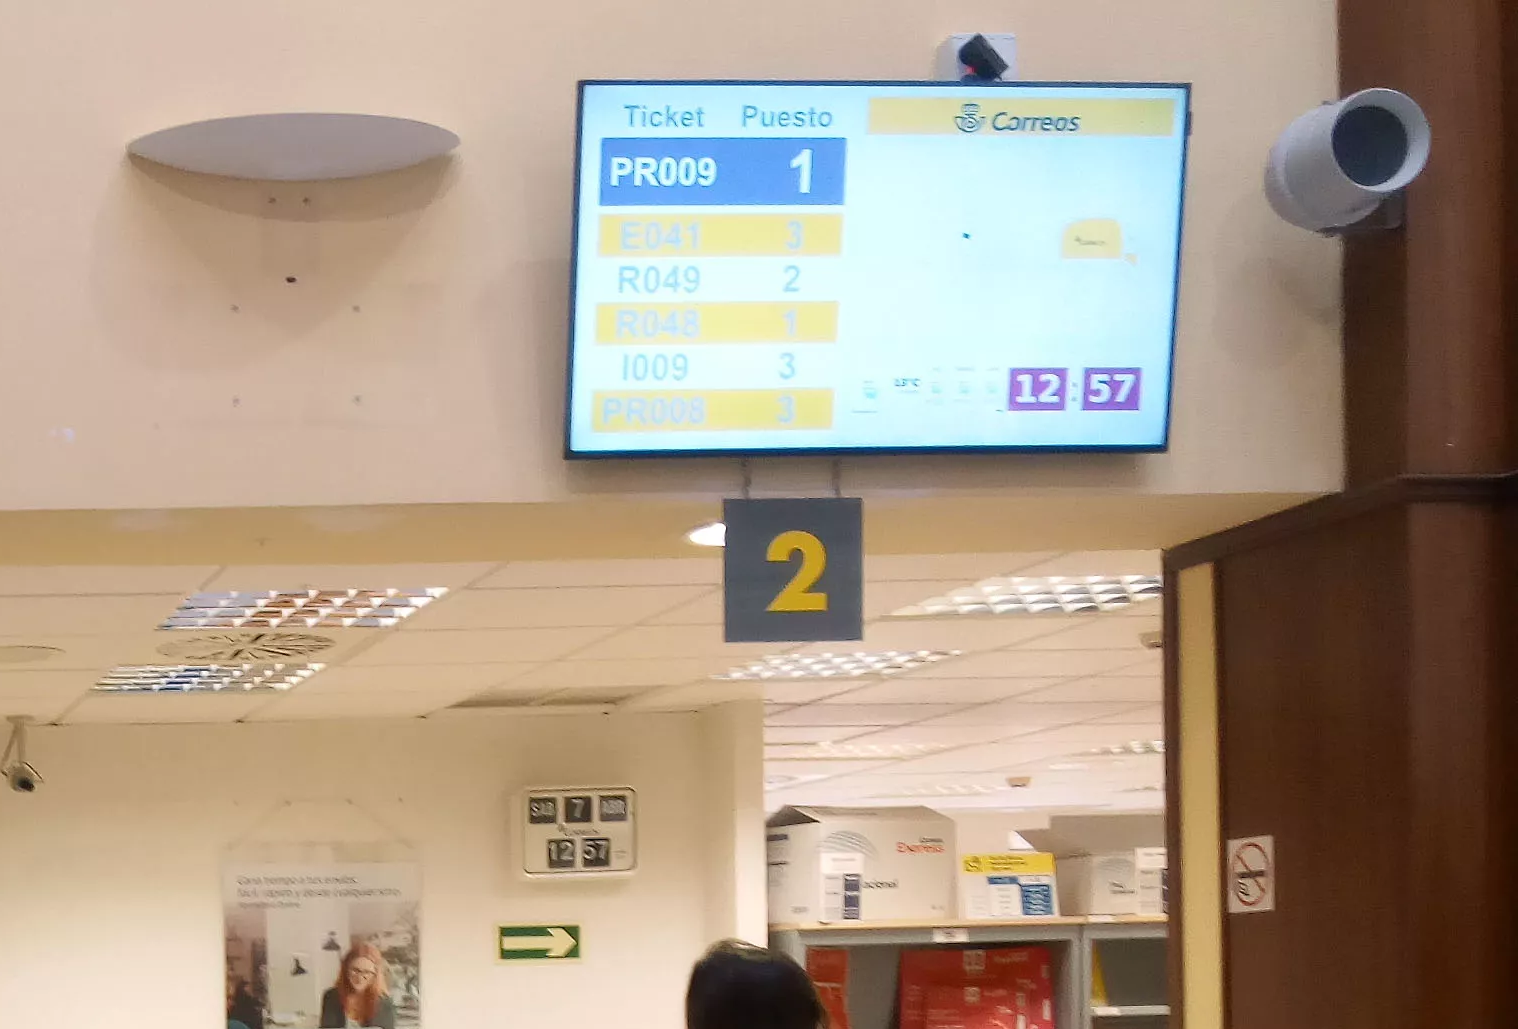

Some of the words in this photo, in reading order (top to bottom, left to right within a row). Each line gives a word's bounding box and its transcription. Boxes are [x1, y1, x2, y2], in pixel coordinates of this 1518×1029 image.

[624, 105, 705, 128] Ticket
[741, 106, 833, 128] Puesto
[991, 112, 1081, 133] Correos
[609, 157, 717, 188] PR009
[789, 148, 813, 194] 1
[620, 221, 702, 251] E041
[785, 220, 804, 250] 3
[618, 265, 701, 294] R049
[783, 265, 800, 293] 2
[615, 309, 701, 339] R048
[783, 310, 797, 337] 1
[778, 353, 796, 380] 3
[1015, 373, 1062, 404] 12
[1088, 373, 1137, 404] 57
[601, 397, 705, 426] PR008
[775, 396, 795, 425] 3
[764, 530, 829, 613] 2
[571, 798, 585, 819] 7
[549, 841, 575, 861] 12
[583, 840, 608, 861] 57
